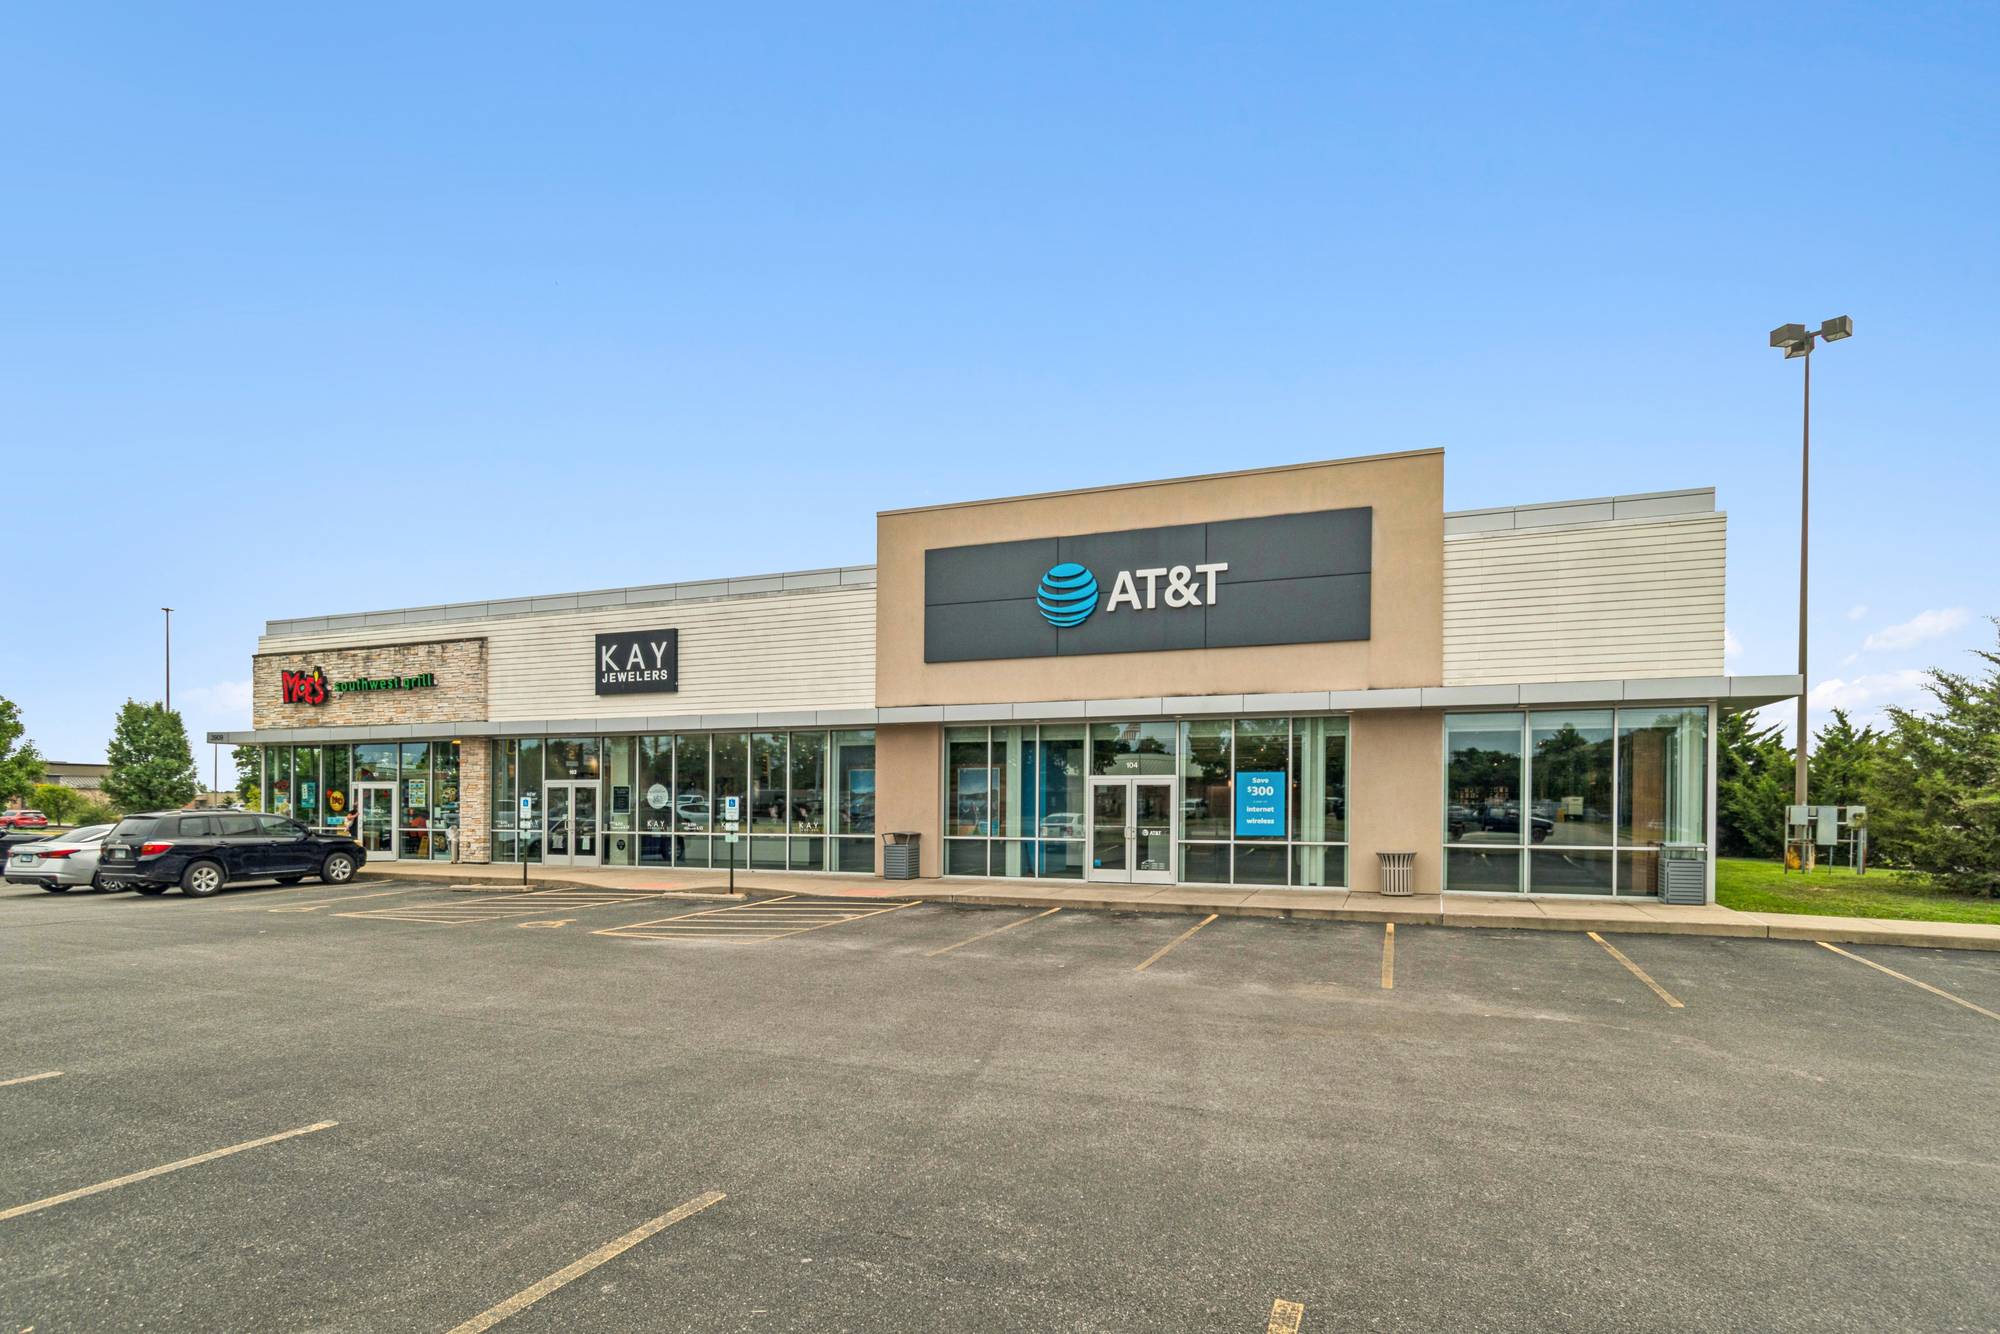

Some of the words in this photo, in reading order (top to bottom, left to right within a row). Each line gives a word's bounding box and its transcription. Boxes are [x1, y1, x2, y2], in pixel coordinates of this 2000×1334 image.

[1106, 562, 1228, 612] AT&T
[601, 641, 668, 672] KAY
[333, 677, 400, 692] southwest
[402, 673, 432, 690] grill
[602, 669, 668, 683] JEWELERS
[1126, 761, 1138, 769] 104
[1247, 786, 1274, 796] $300
